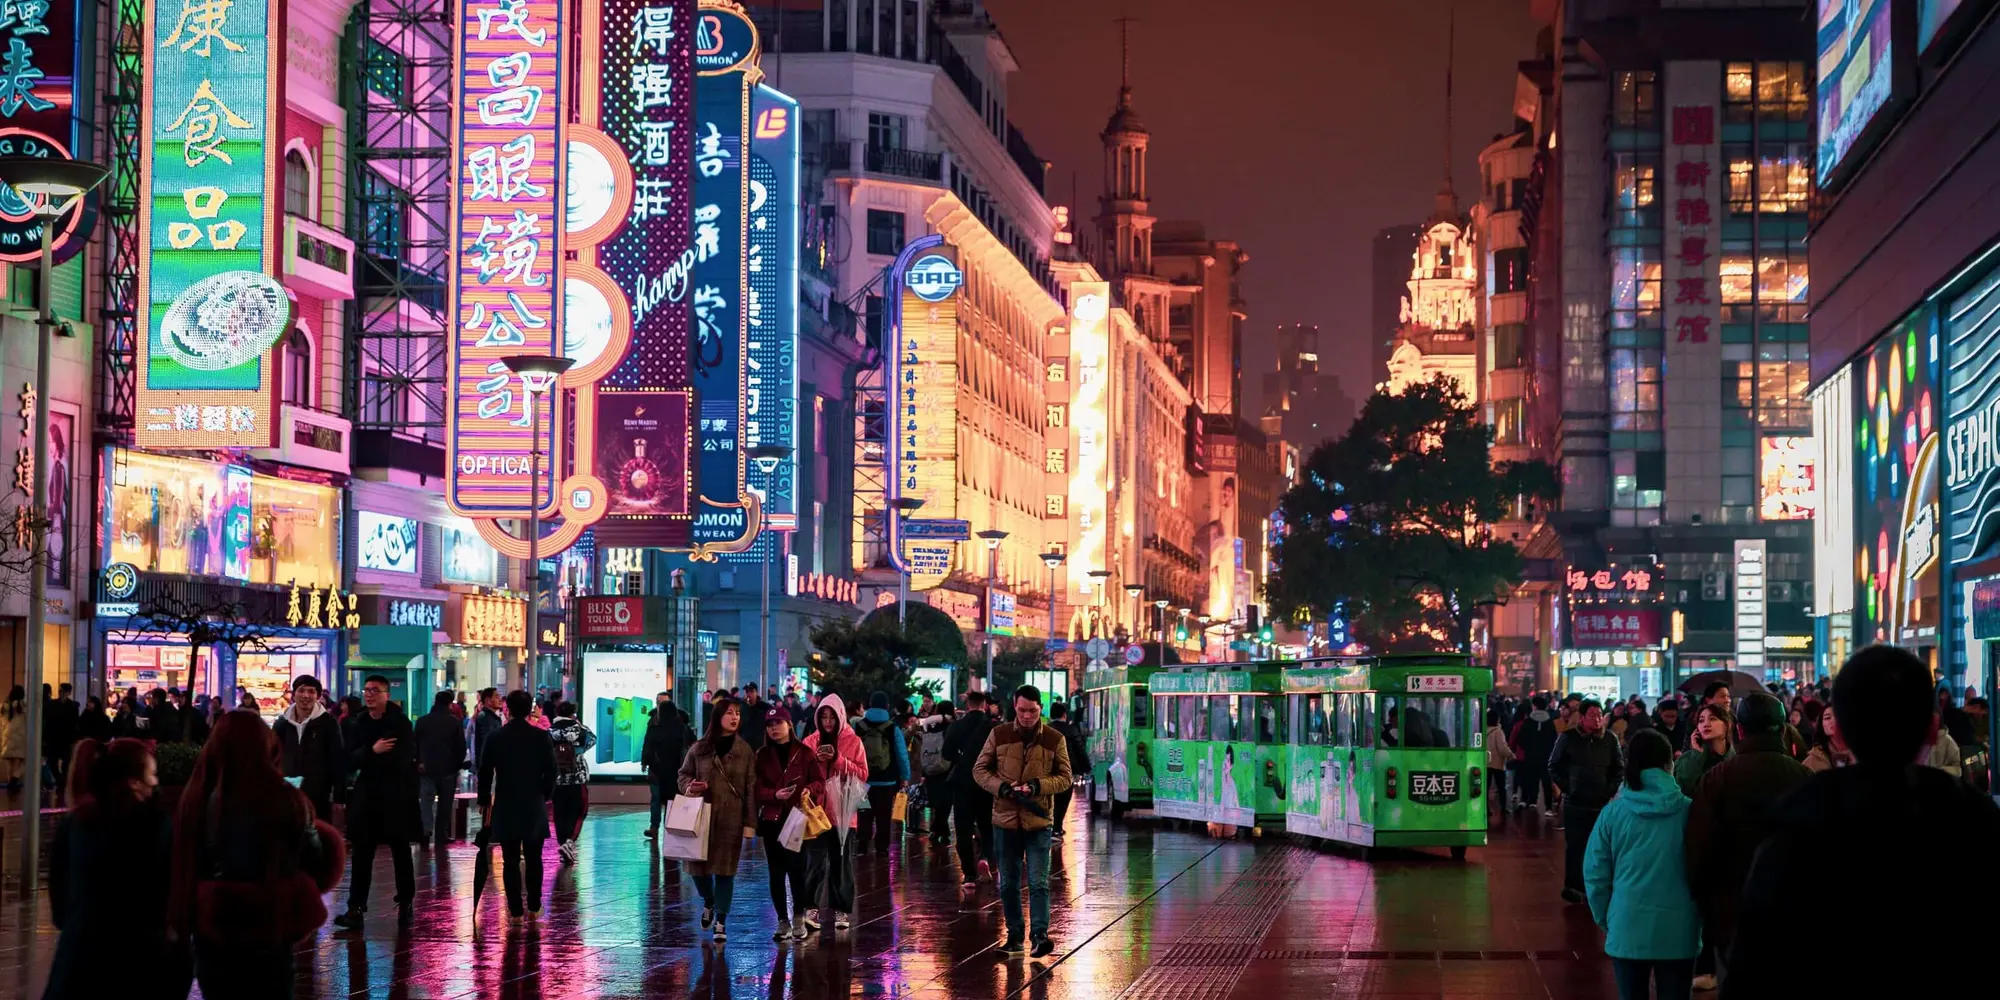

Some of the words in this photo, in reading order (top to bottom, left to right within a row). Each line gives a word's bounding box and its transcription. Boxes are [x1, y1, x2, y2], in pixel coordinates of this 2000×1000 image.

[632, 240, 700, 326] hamp
[907, 271, 961, 285] BAC
[777, 397, 793, 500] Pharacy
[461, 455, 543, 475] OPTICA
[703, 530, 736, 538] WEAR
[285, 578, 360, 629] 泰康食品
[587, 603, 613, 614] BUS
[587, 616, 613, 624] TOUR
[1412, 775, 1456, 796] 豆本豆
